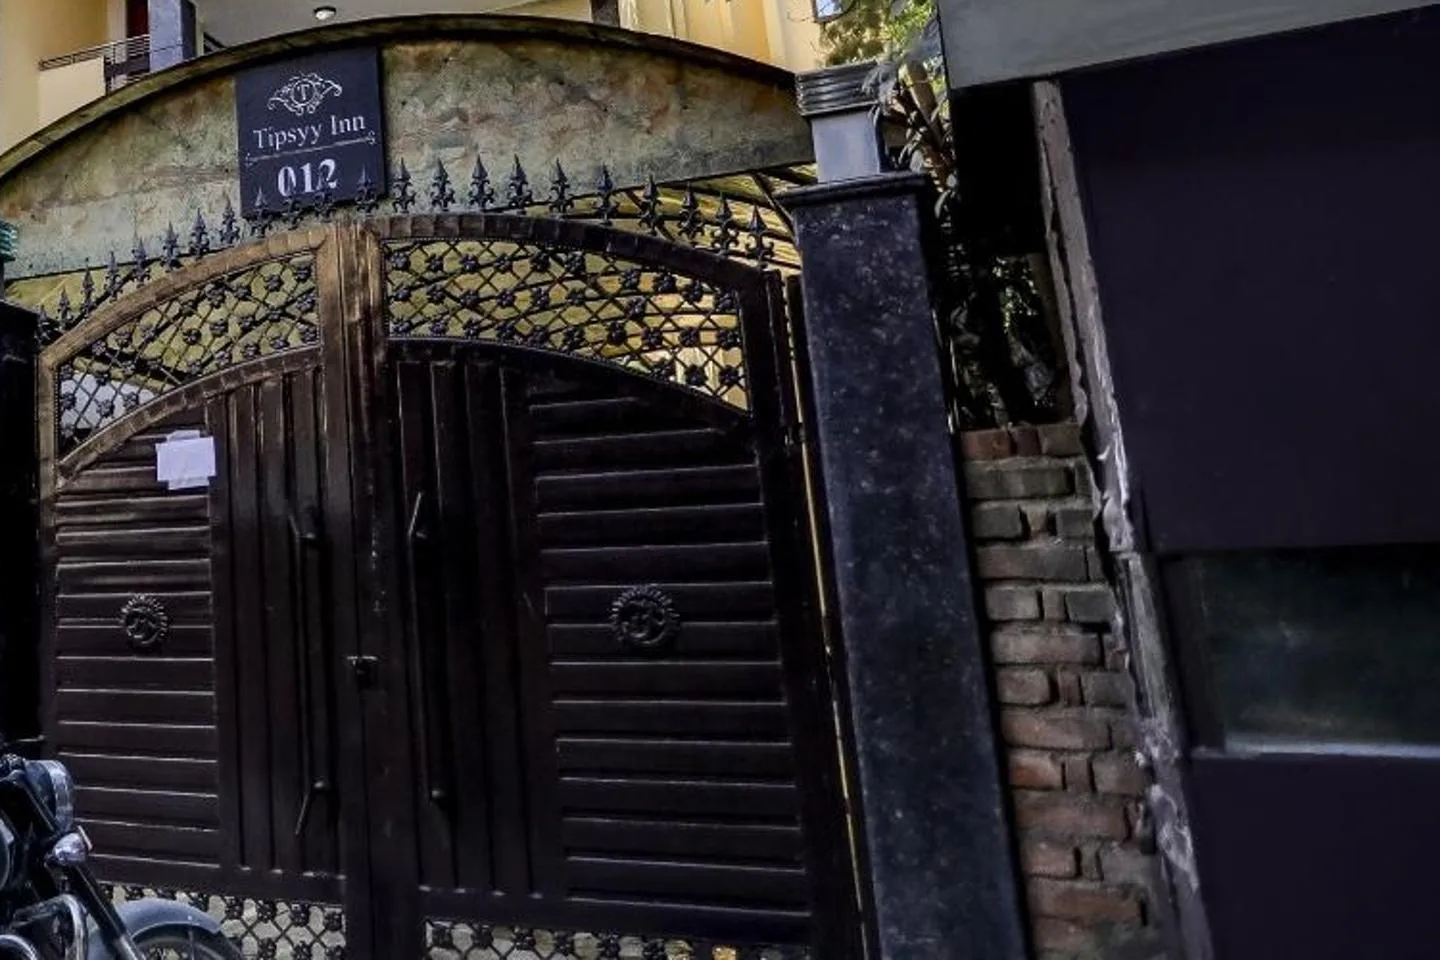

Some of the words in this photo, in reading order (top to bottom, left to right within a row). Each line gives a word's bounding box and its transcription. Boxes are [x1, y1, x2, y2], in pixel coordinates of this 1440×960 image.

[253, 123, 323, 151] Tipsyy
[331, 114, 366, 136] Inn
[277, 158, 338, 198] 012
